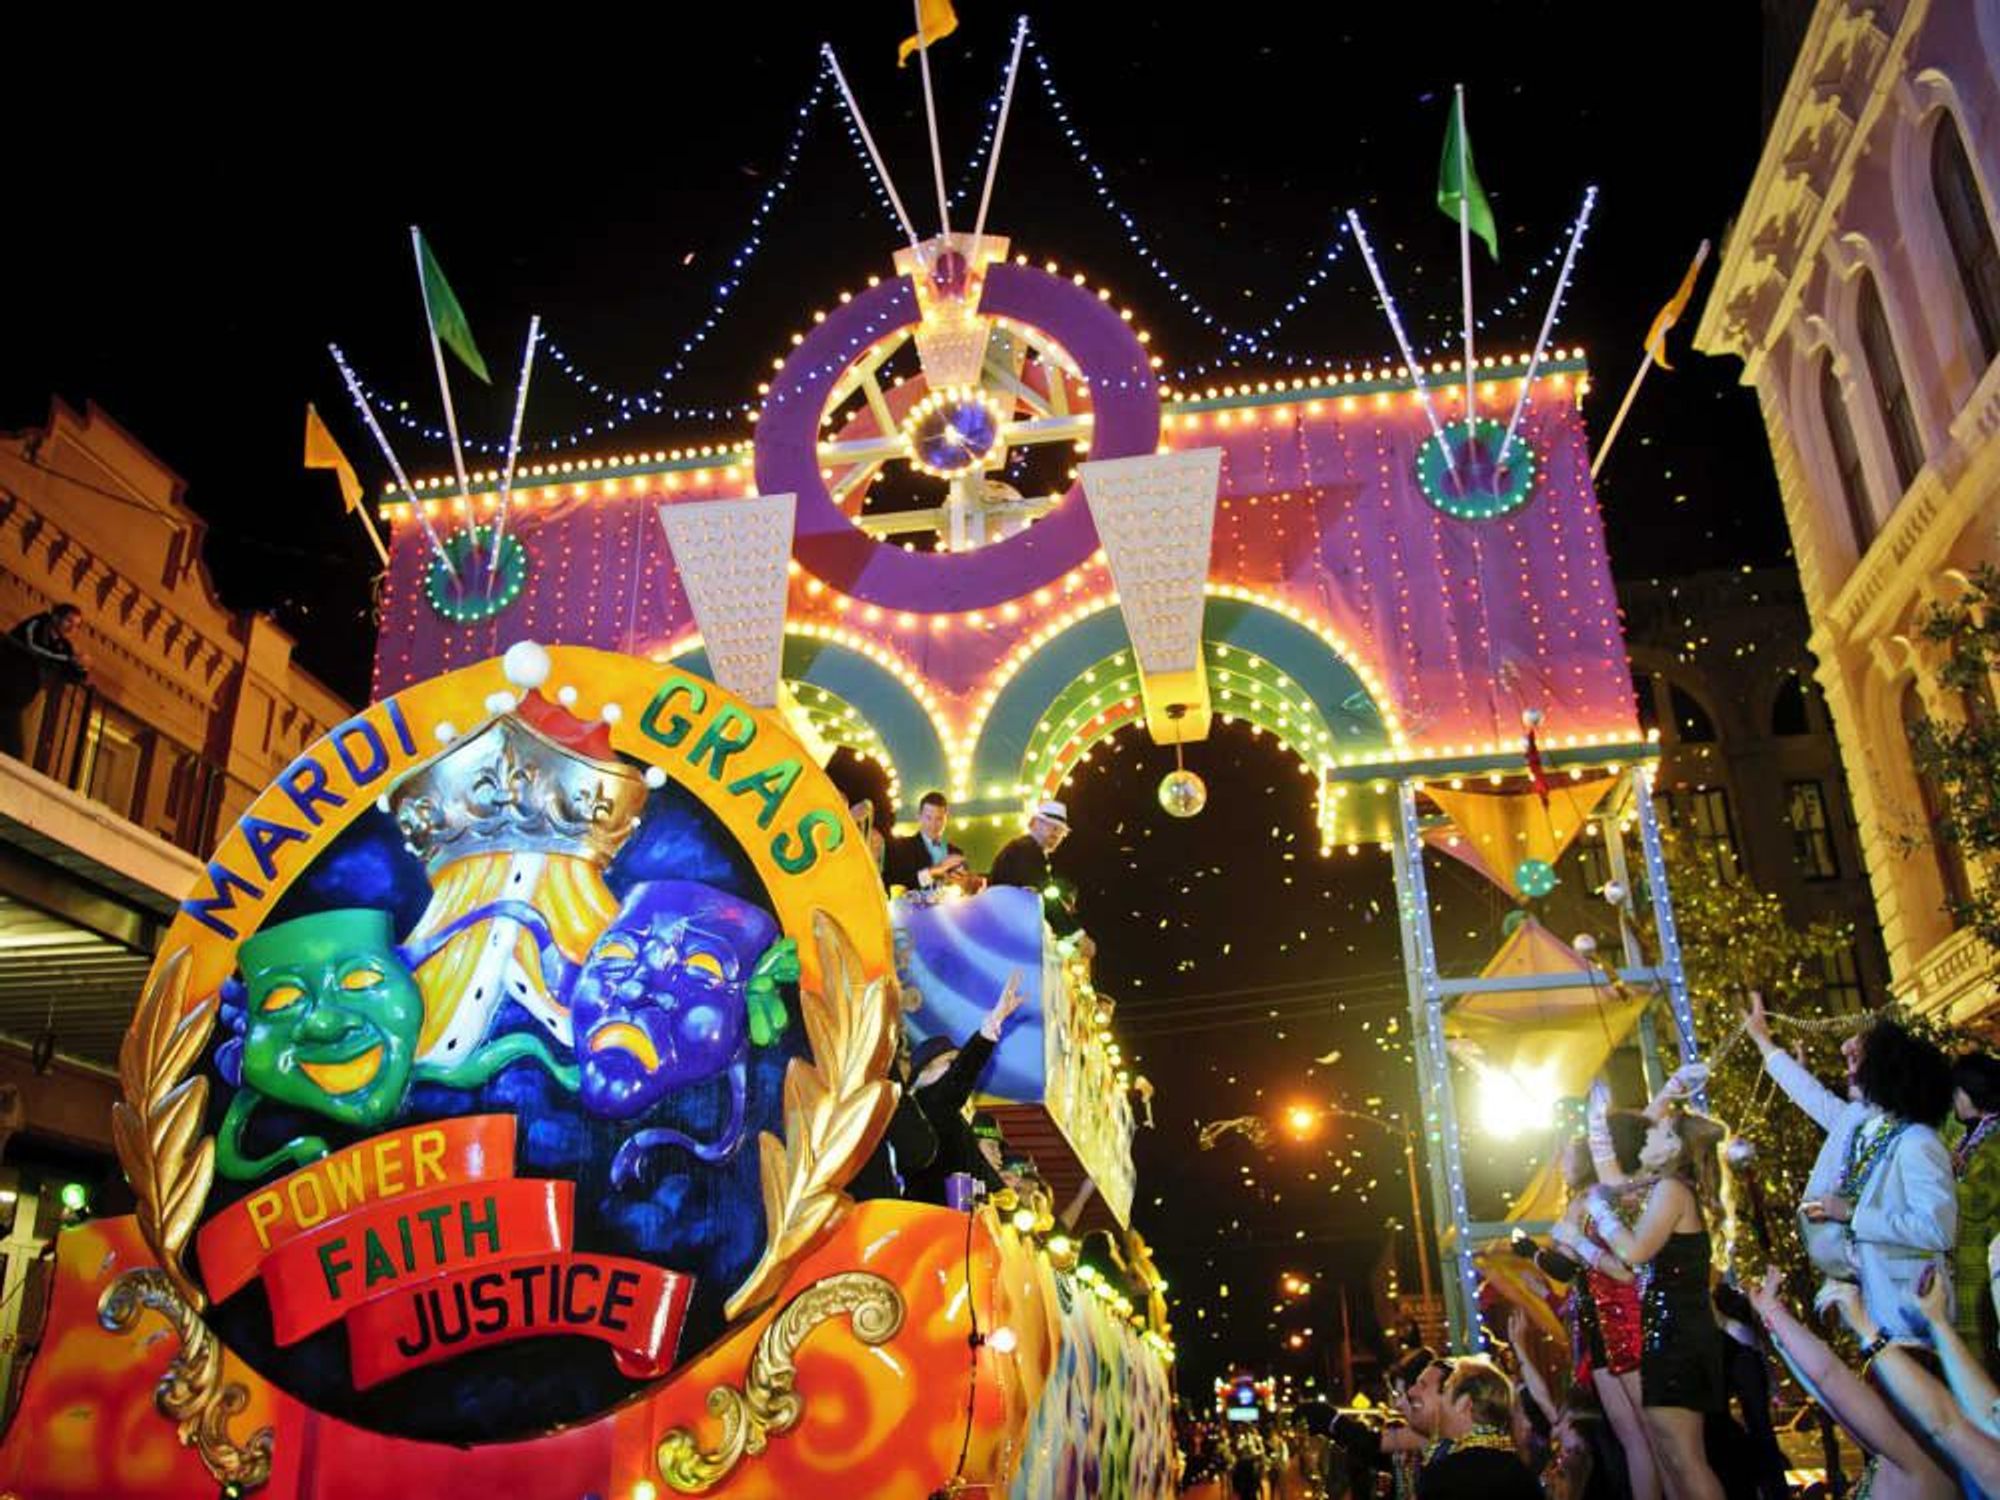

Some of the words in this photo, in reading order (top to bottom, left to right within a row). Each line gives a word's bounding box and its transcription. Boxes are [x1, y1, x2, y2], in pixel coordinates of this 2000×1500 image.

[182, 698, 419, 940] MARDI
[638, 676, 845, 875] GRAS
[246, 1129, 447, 1250] POWER
[318, 1197, 500, 1298] FAITH
[395, 1264, 641, 1356] JUSTICE
